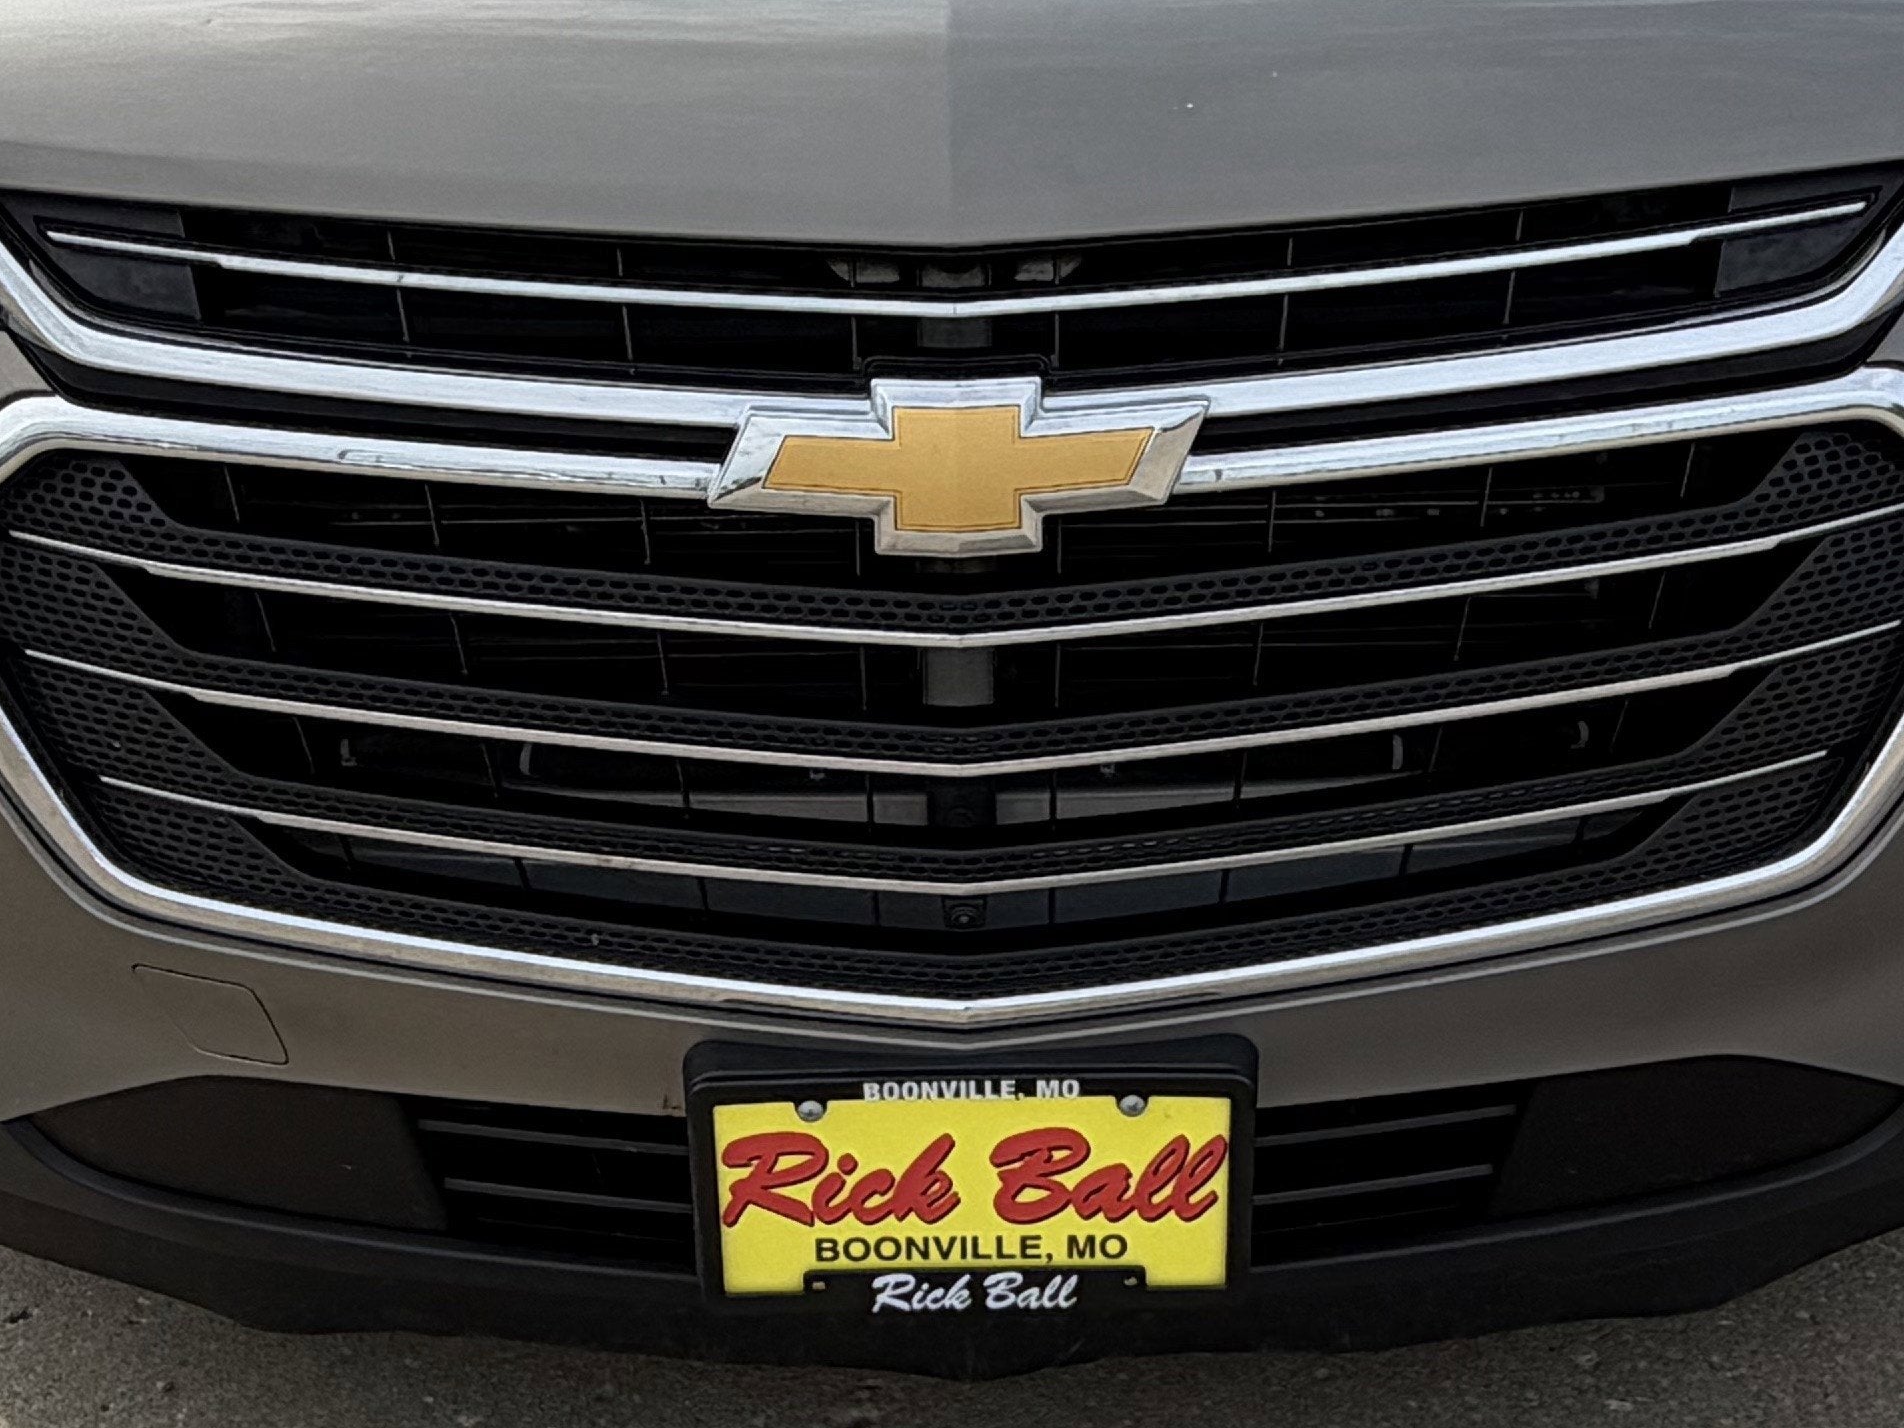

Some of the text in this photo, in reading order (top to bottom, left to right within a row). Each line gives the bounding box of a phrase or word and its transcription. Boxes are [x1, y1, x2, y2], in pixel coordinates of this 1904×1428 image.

[862, 1078, 1081, 1102] BOONVILLE, MO
[721, 1126, 1229, 1228] Rick Ball
[814, 1233, 1130, 1263] BOONVILLE, MO
[871, 1273, 1079, 1314] Rick Ball
